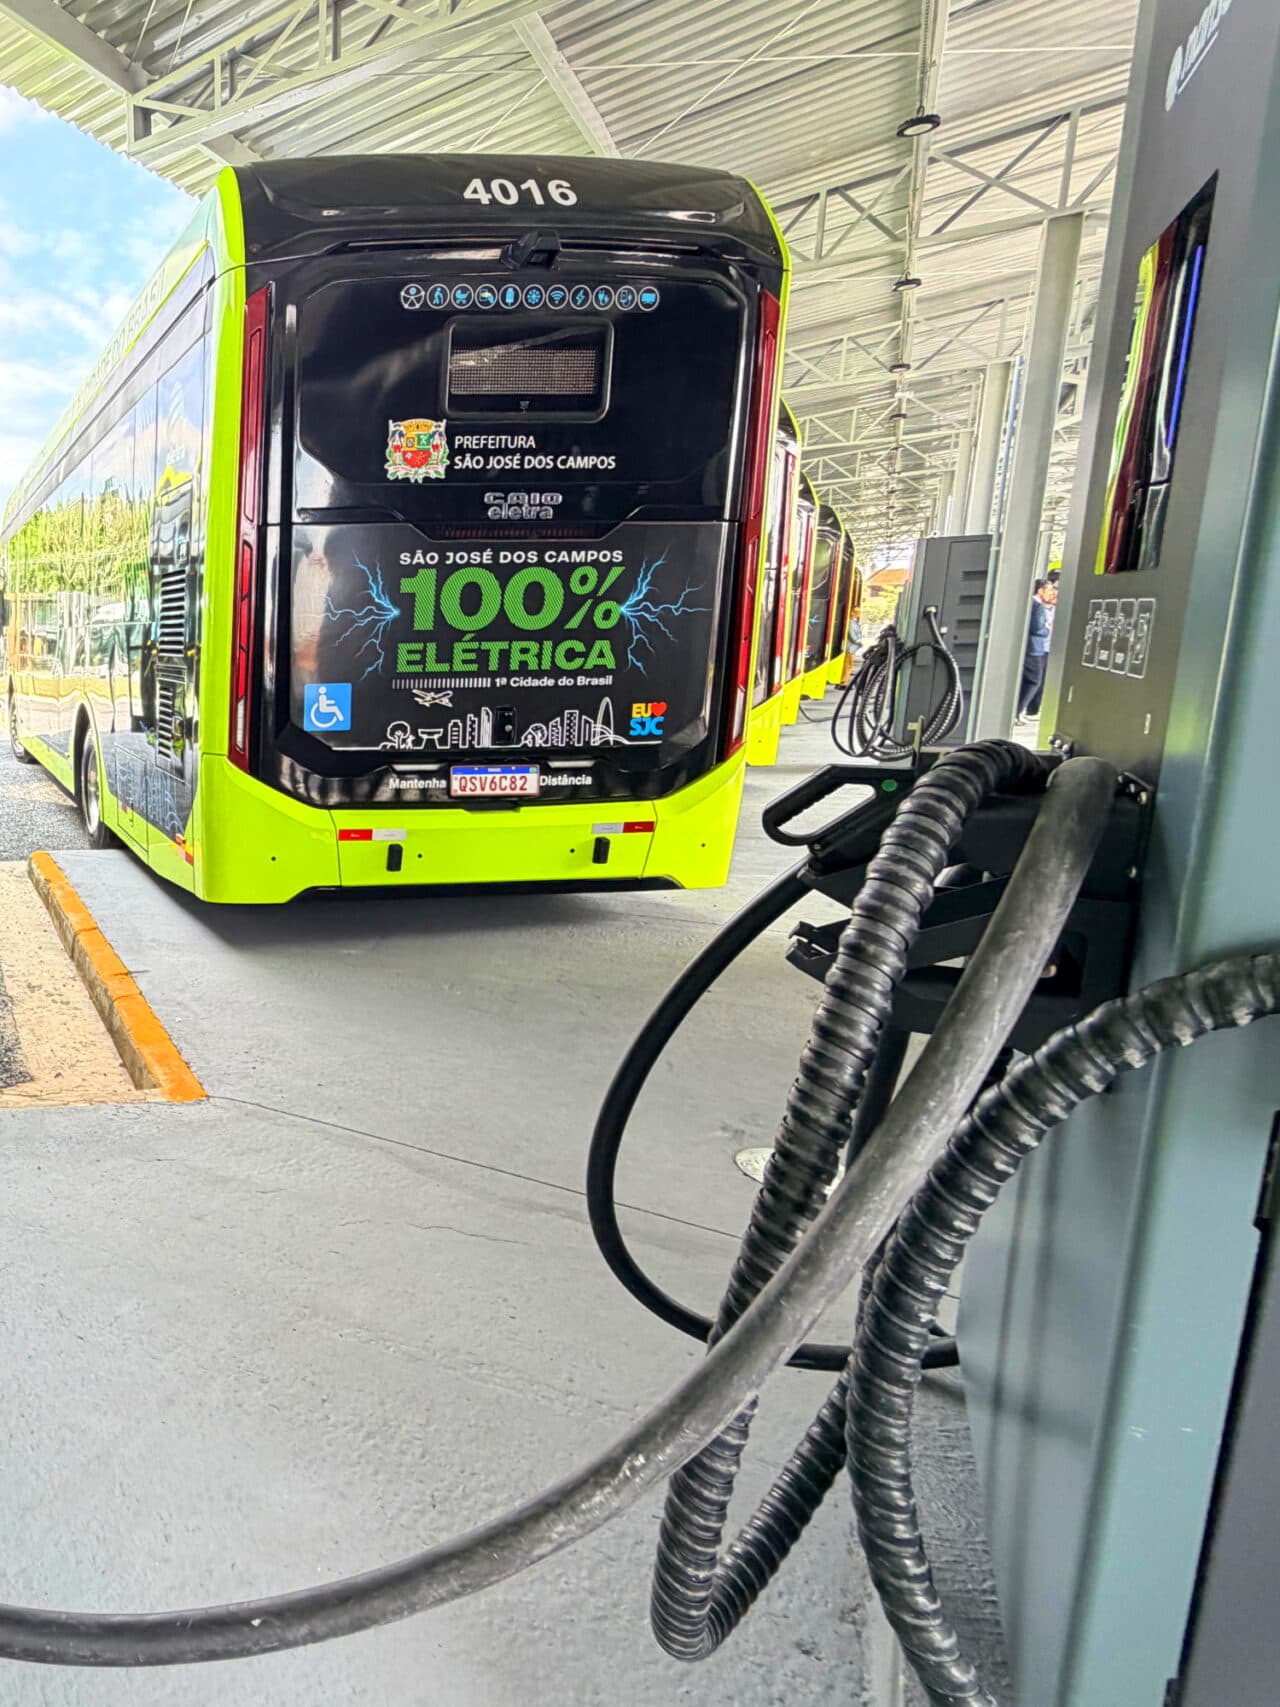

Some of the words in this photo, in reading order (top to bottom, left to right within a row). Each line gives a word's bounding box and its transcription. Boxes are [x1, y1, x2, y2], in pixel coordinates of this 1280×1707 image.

[462, 177, 578, 206] 4016
[454, 435, 536, 449] PREFEITURA
[453, 451, 483, 470] SÃO
[485, 451, 521, 470] JOSÉ
[523, 455, 554, 469] DOS
[556, 455, 616, 469] CAMPOS
[488, 503, 554, 520] eletra
[399, 550, 439, 565] SÃO
[445, 548, 493, 565] JOSÉ
[499, 551, 538, 564] DOS
[544, 549, 624, 564] CAMPOS
[399, 566, 626, 632] 100%
[396, 633, 617, 673] ELÉTRICA
[509, 676, 555, 688] Cidade
[557, 676, 574, 687] do
[576, 674, 613, 686] Brasil
[632, 703, 652, 718] EU
[630, 716, 665, 736] SJC
[389, 777, 447, 789] Mantenha
[539, 774, 593, 786] Distância
[459, 775, 528, 792] QSV6C82
